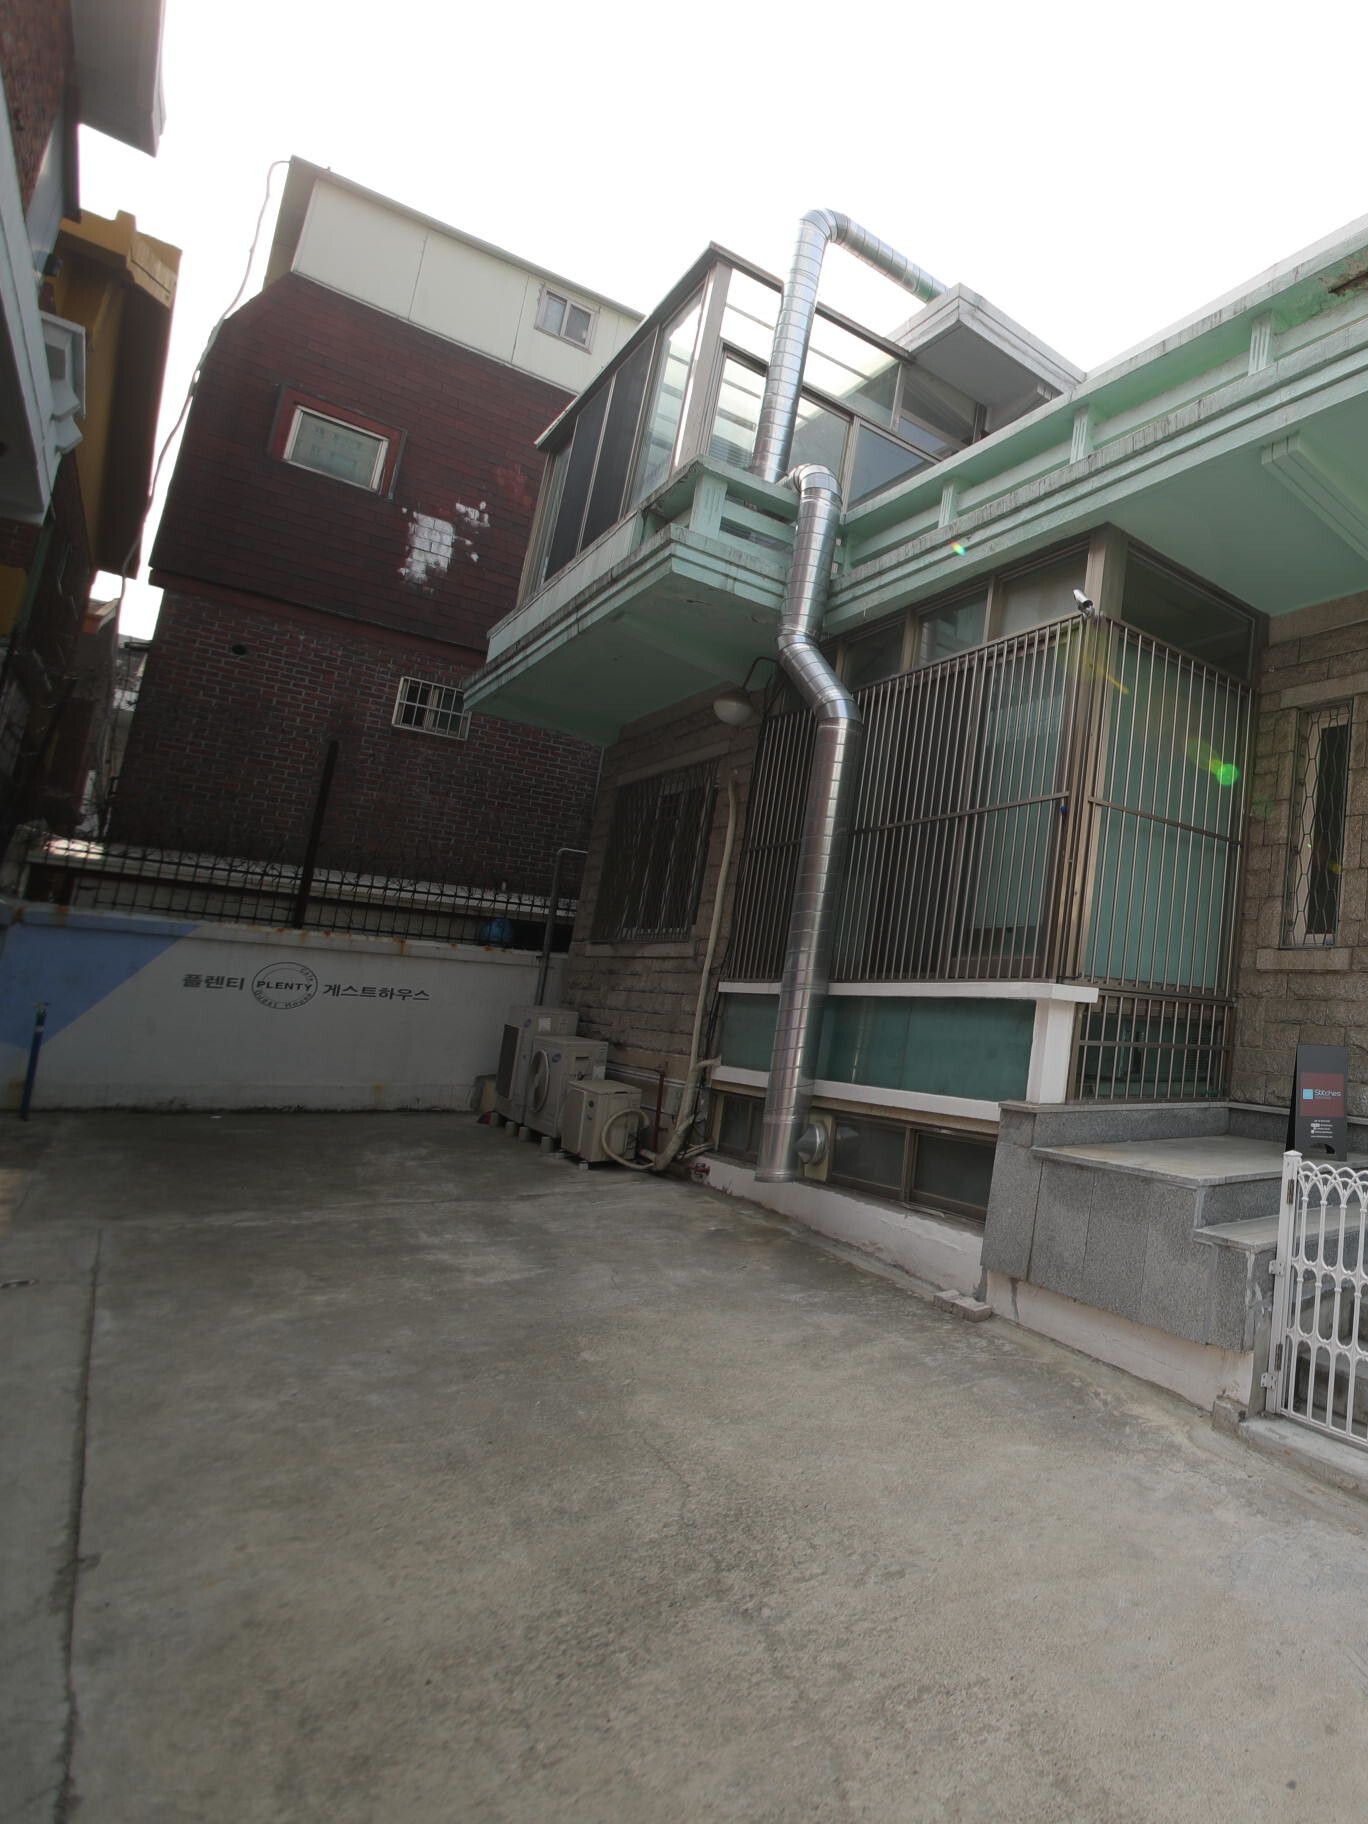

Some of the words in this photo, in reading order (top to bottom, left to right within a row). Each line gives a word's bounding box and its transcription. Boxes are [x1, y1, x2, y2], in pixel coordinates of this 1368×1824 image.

[182, 973, 246, 991] 플렌티
[256, 981, 313, 991] PLENTY
[322, 983, 431, 1001] 게스트하우스
